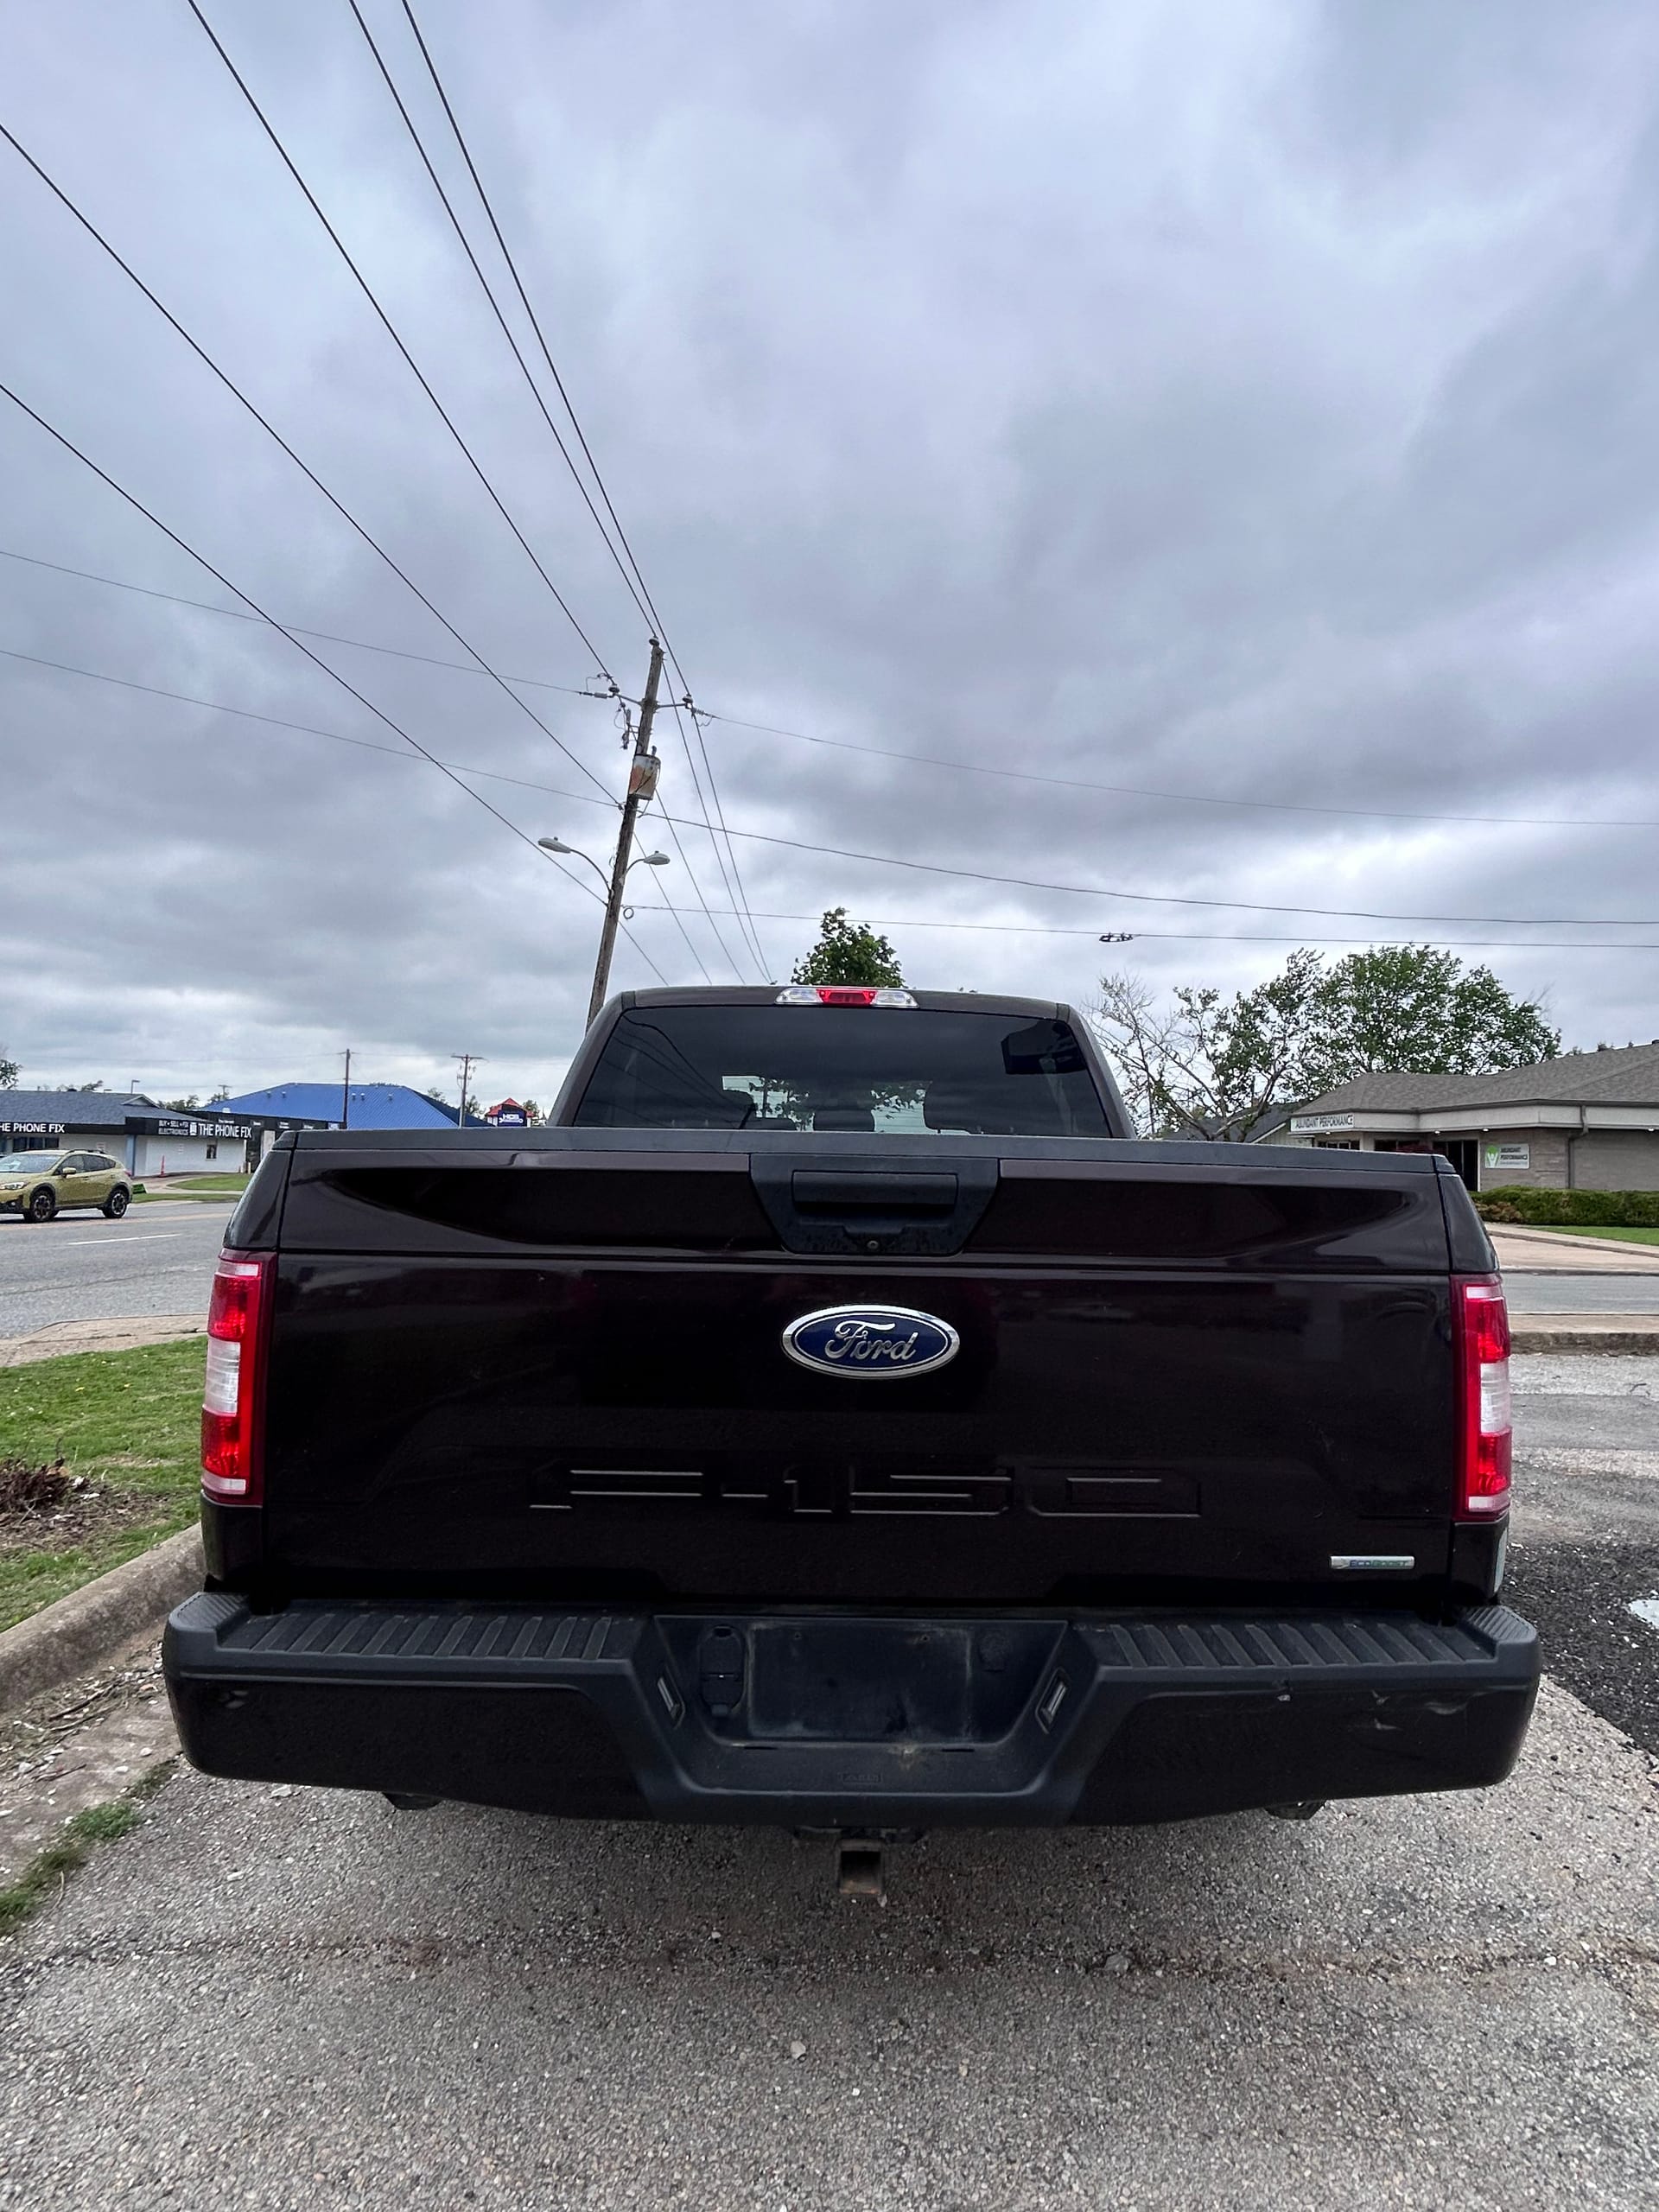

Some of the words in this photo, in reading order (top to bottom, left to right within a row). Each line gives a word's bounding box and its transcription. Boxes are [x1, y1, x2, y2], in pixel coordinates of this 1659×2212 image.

[13, 1122, 47, 1133] PHONE
[48, 1123, 66, 1134] FIX
[199, 1122, 214, 1136] THE
[214, 1124, 239, 1138] PHONE
[240, 1126, 252, 1139] FIX
[823, 1319, 920, 1361] Ford
